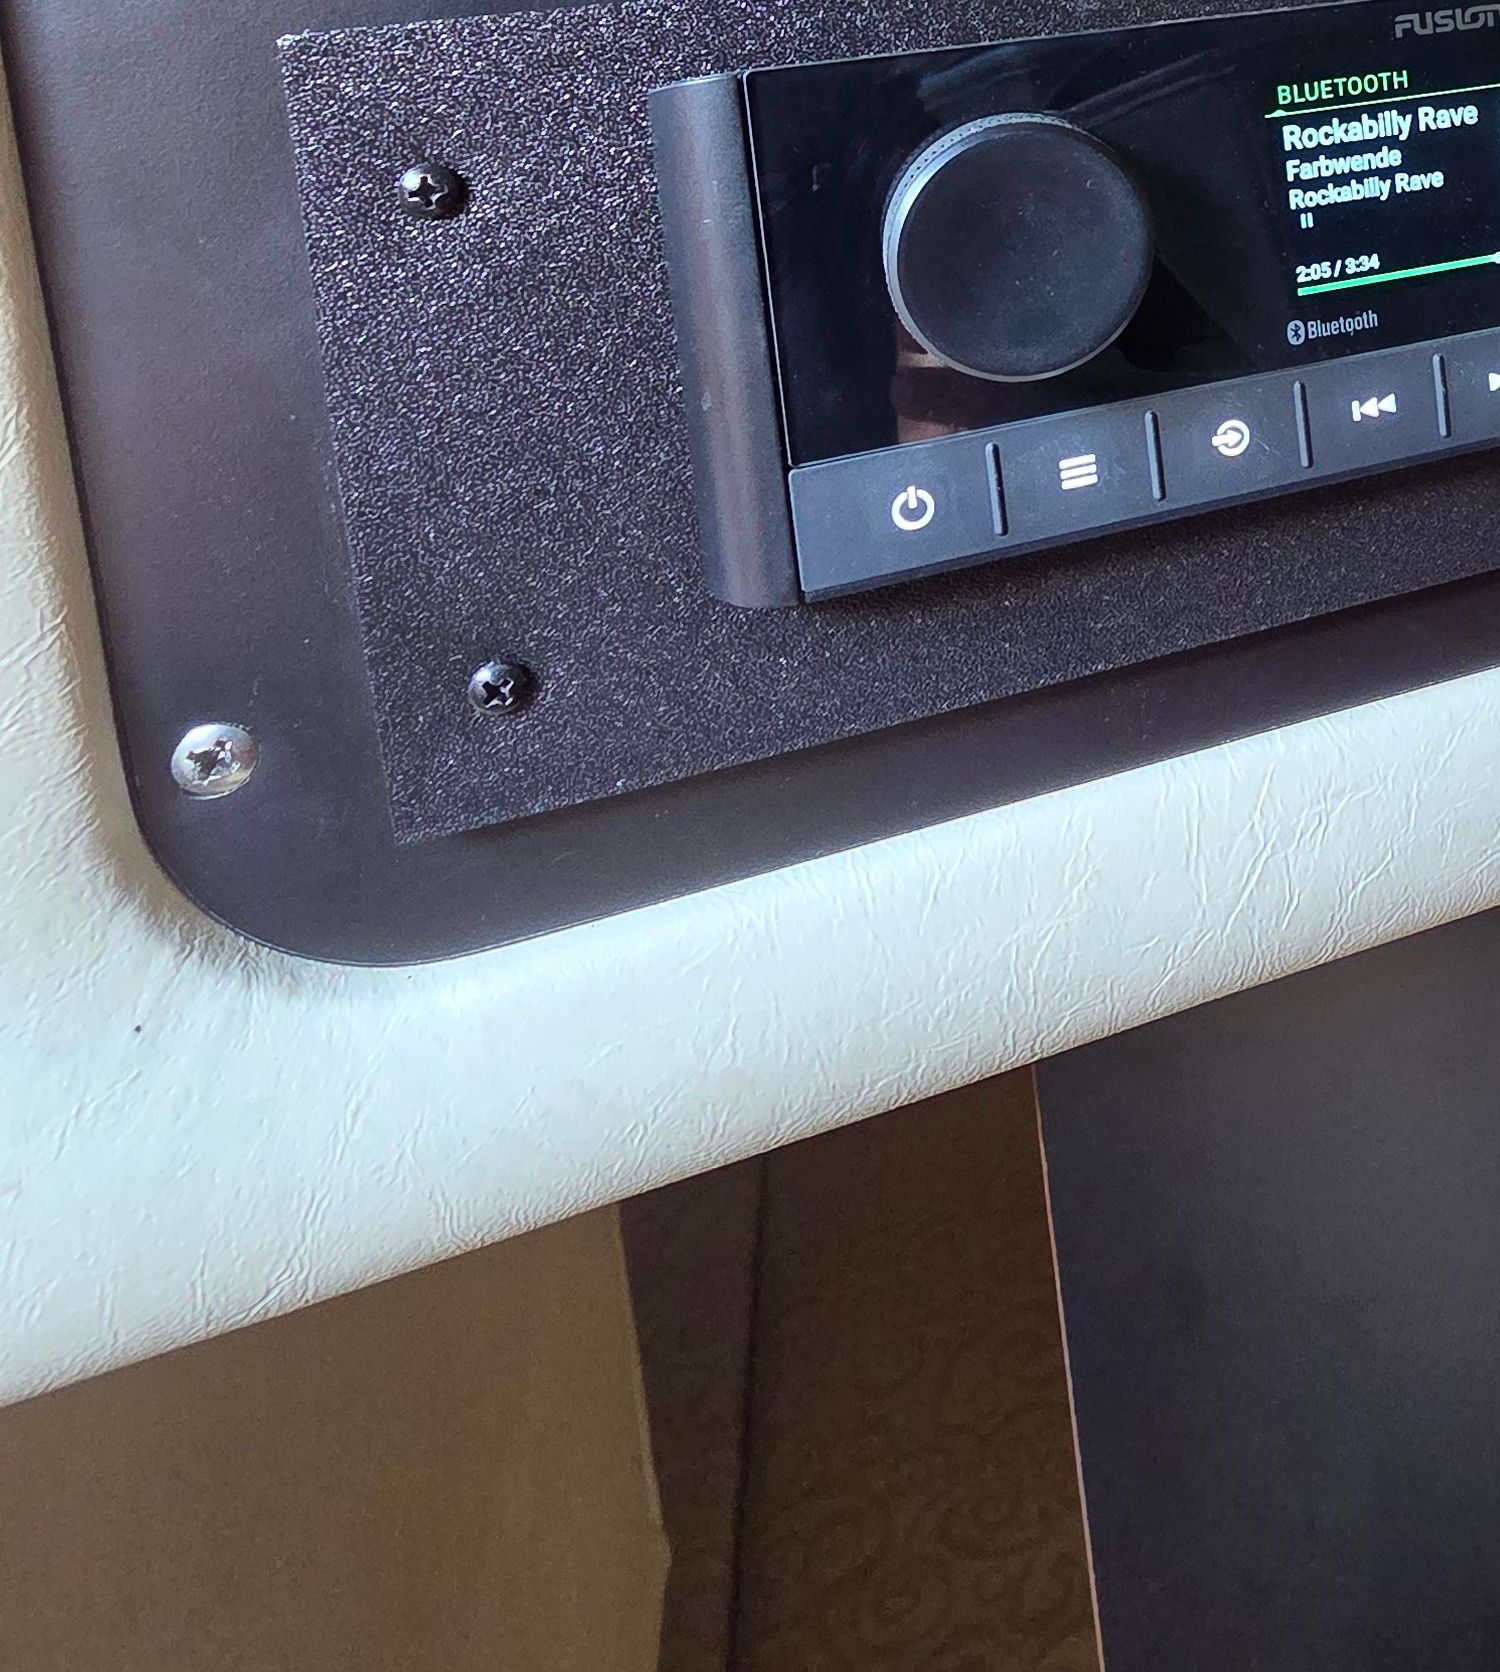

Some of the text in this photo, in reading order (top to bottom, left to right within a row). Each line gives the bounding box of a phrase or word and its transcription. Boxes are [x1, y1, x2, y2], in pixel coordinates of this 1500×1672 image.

[1276, 70, 1409, 105] BLUETOOTH
[1282, 102, 1479, 152] Rockabilly Rave
[1285, 146, 1402, 182] Farbwende
[1289, 168, 1444, 210] Rockabilly Rave
[1295, 261, 1333, 283] 2:05
[1344, 253, 1380, 274] 3:34
[1307, 309, 1379, 341] Bluetooth
